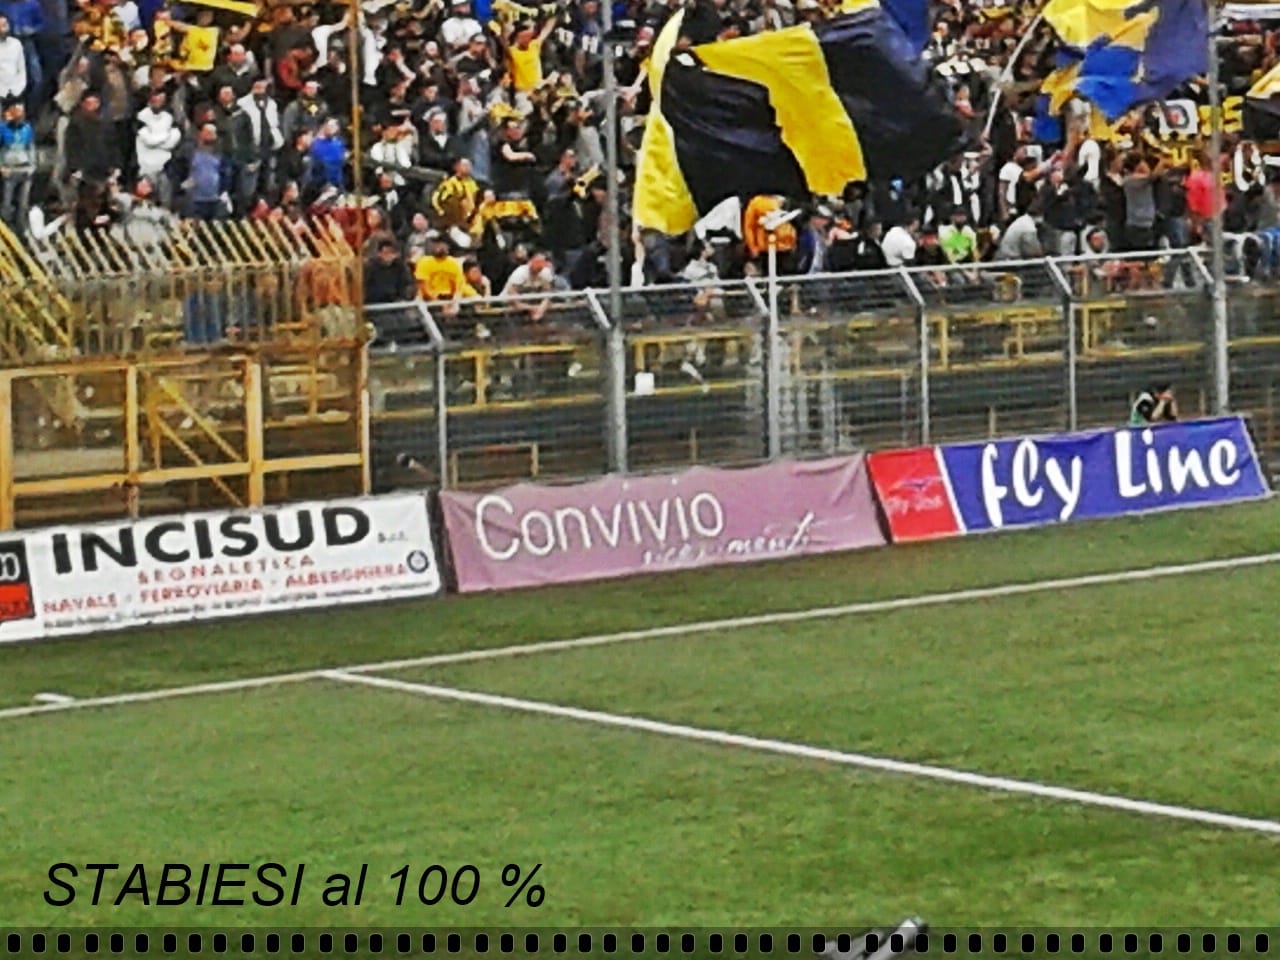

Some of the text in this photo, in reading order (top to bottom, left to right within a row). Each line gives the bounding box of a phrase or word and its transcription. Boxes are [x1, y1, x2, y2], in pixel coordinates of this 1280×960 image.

[981, 428, 1241, 529] fly Line
[52, 506, 371, 575] INCISUD
[43, 592, 118, 614] NAVALE
[139, 577, 263, 604] FERROVIARIA
[138, 554, 315, 585] SEGNALETICA
